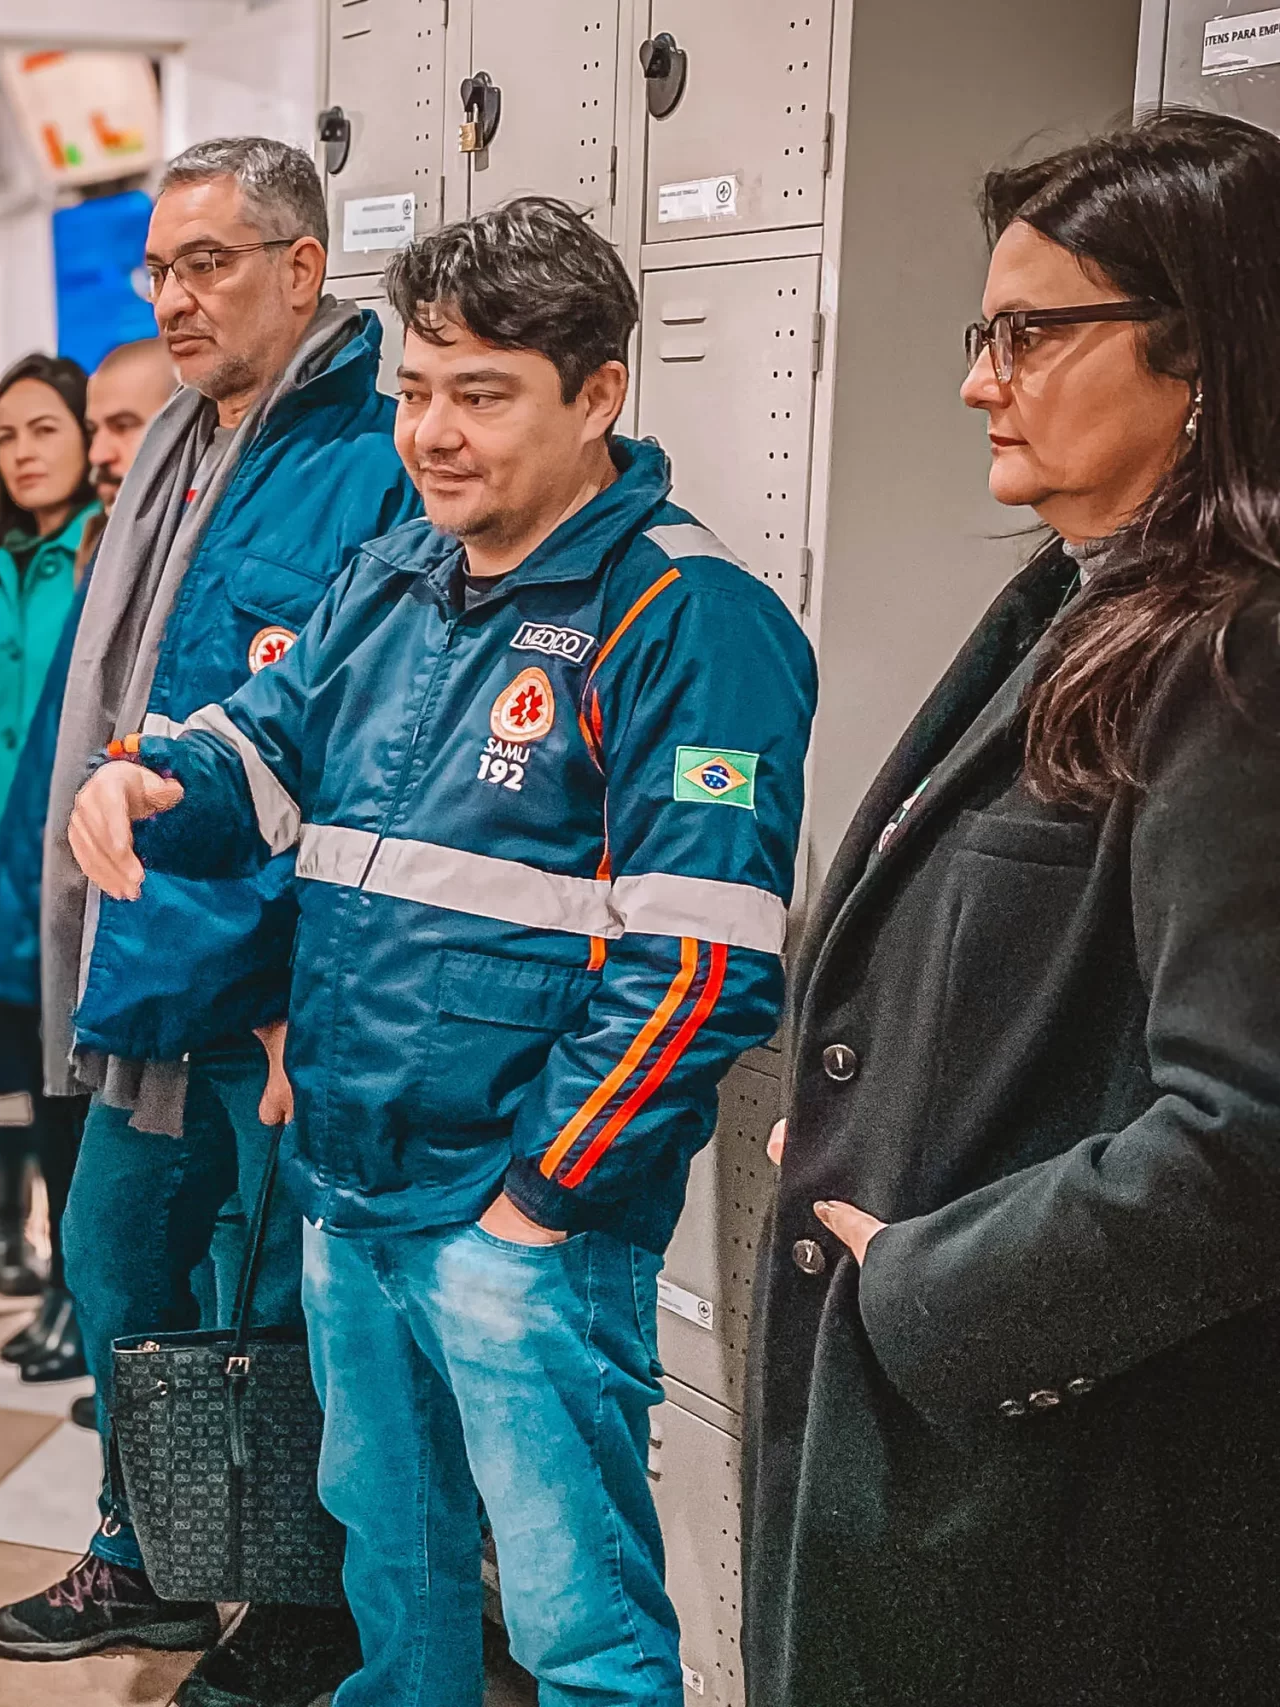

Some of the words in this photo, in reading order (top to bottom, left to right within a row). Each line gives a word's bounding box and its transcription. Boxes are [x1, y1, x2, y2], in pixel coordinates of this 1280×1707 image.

[1205, 33, 1229, 46] ITENS
[1232, 28, 1256, 41] PARA
[1259, 23, 1280, 37] EMP
[484, 737, 531, 764] SAMU
[477, 753, 525, 792] 192
